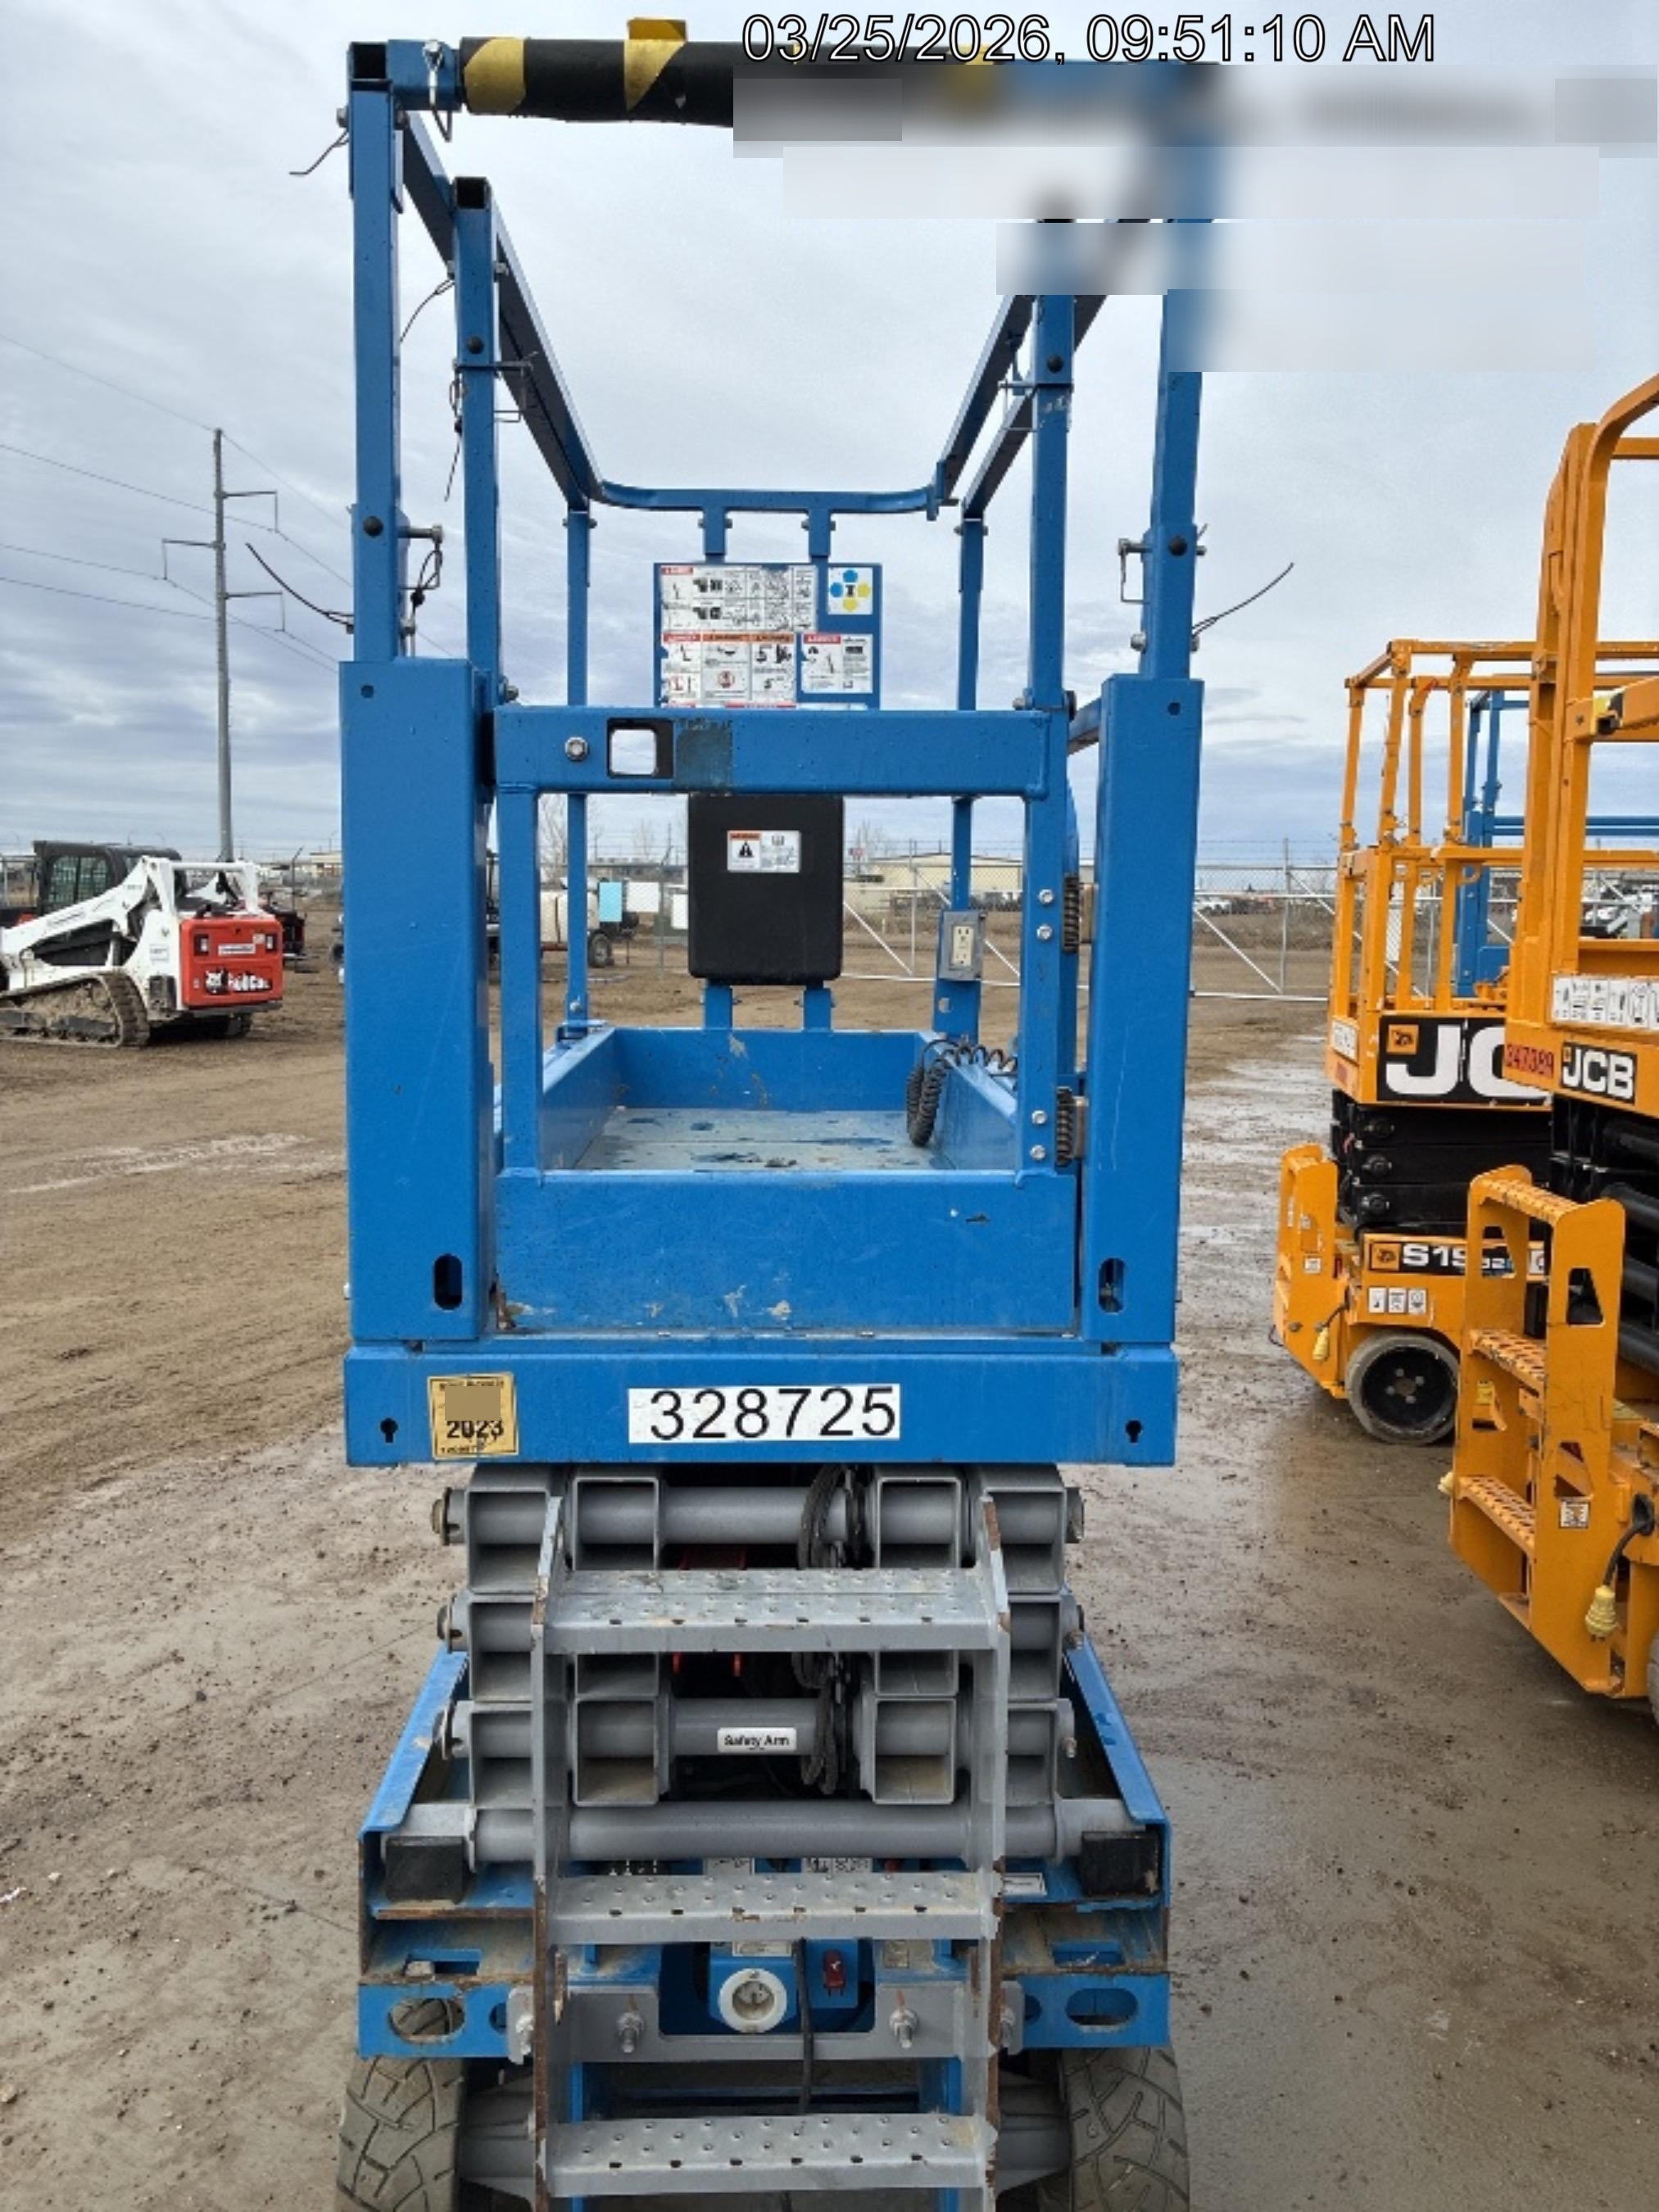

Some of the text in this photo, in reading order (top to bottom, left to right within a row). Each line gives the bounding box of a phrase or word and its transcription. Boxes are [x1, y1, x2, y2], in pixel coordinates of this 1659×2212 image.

[1562, 1047, 1634, 1099] JCB
[650, 1386, 895, 1440] 328725
[764, 1734, 790, 1746] Arm
